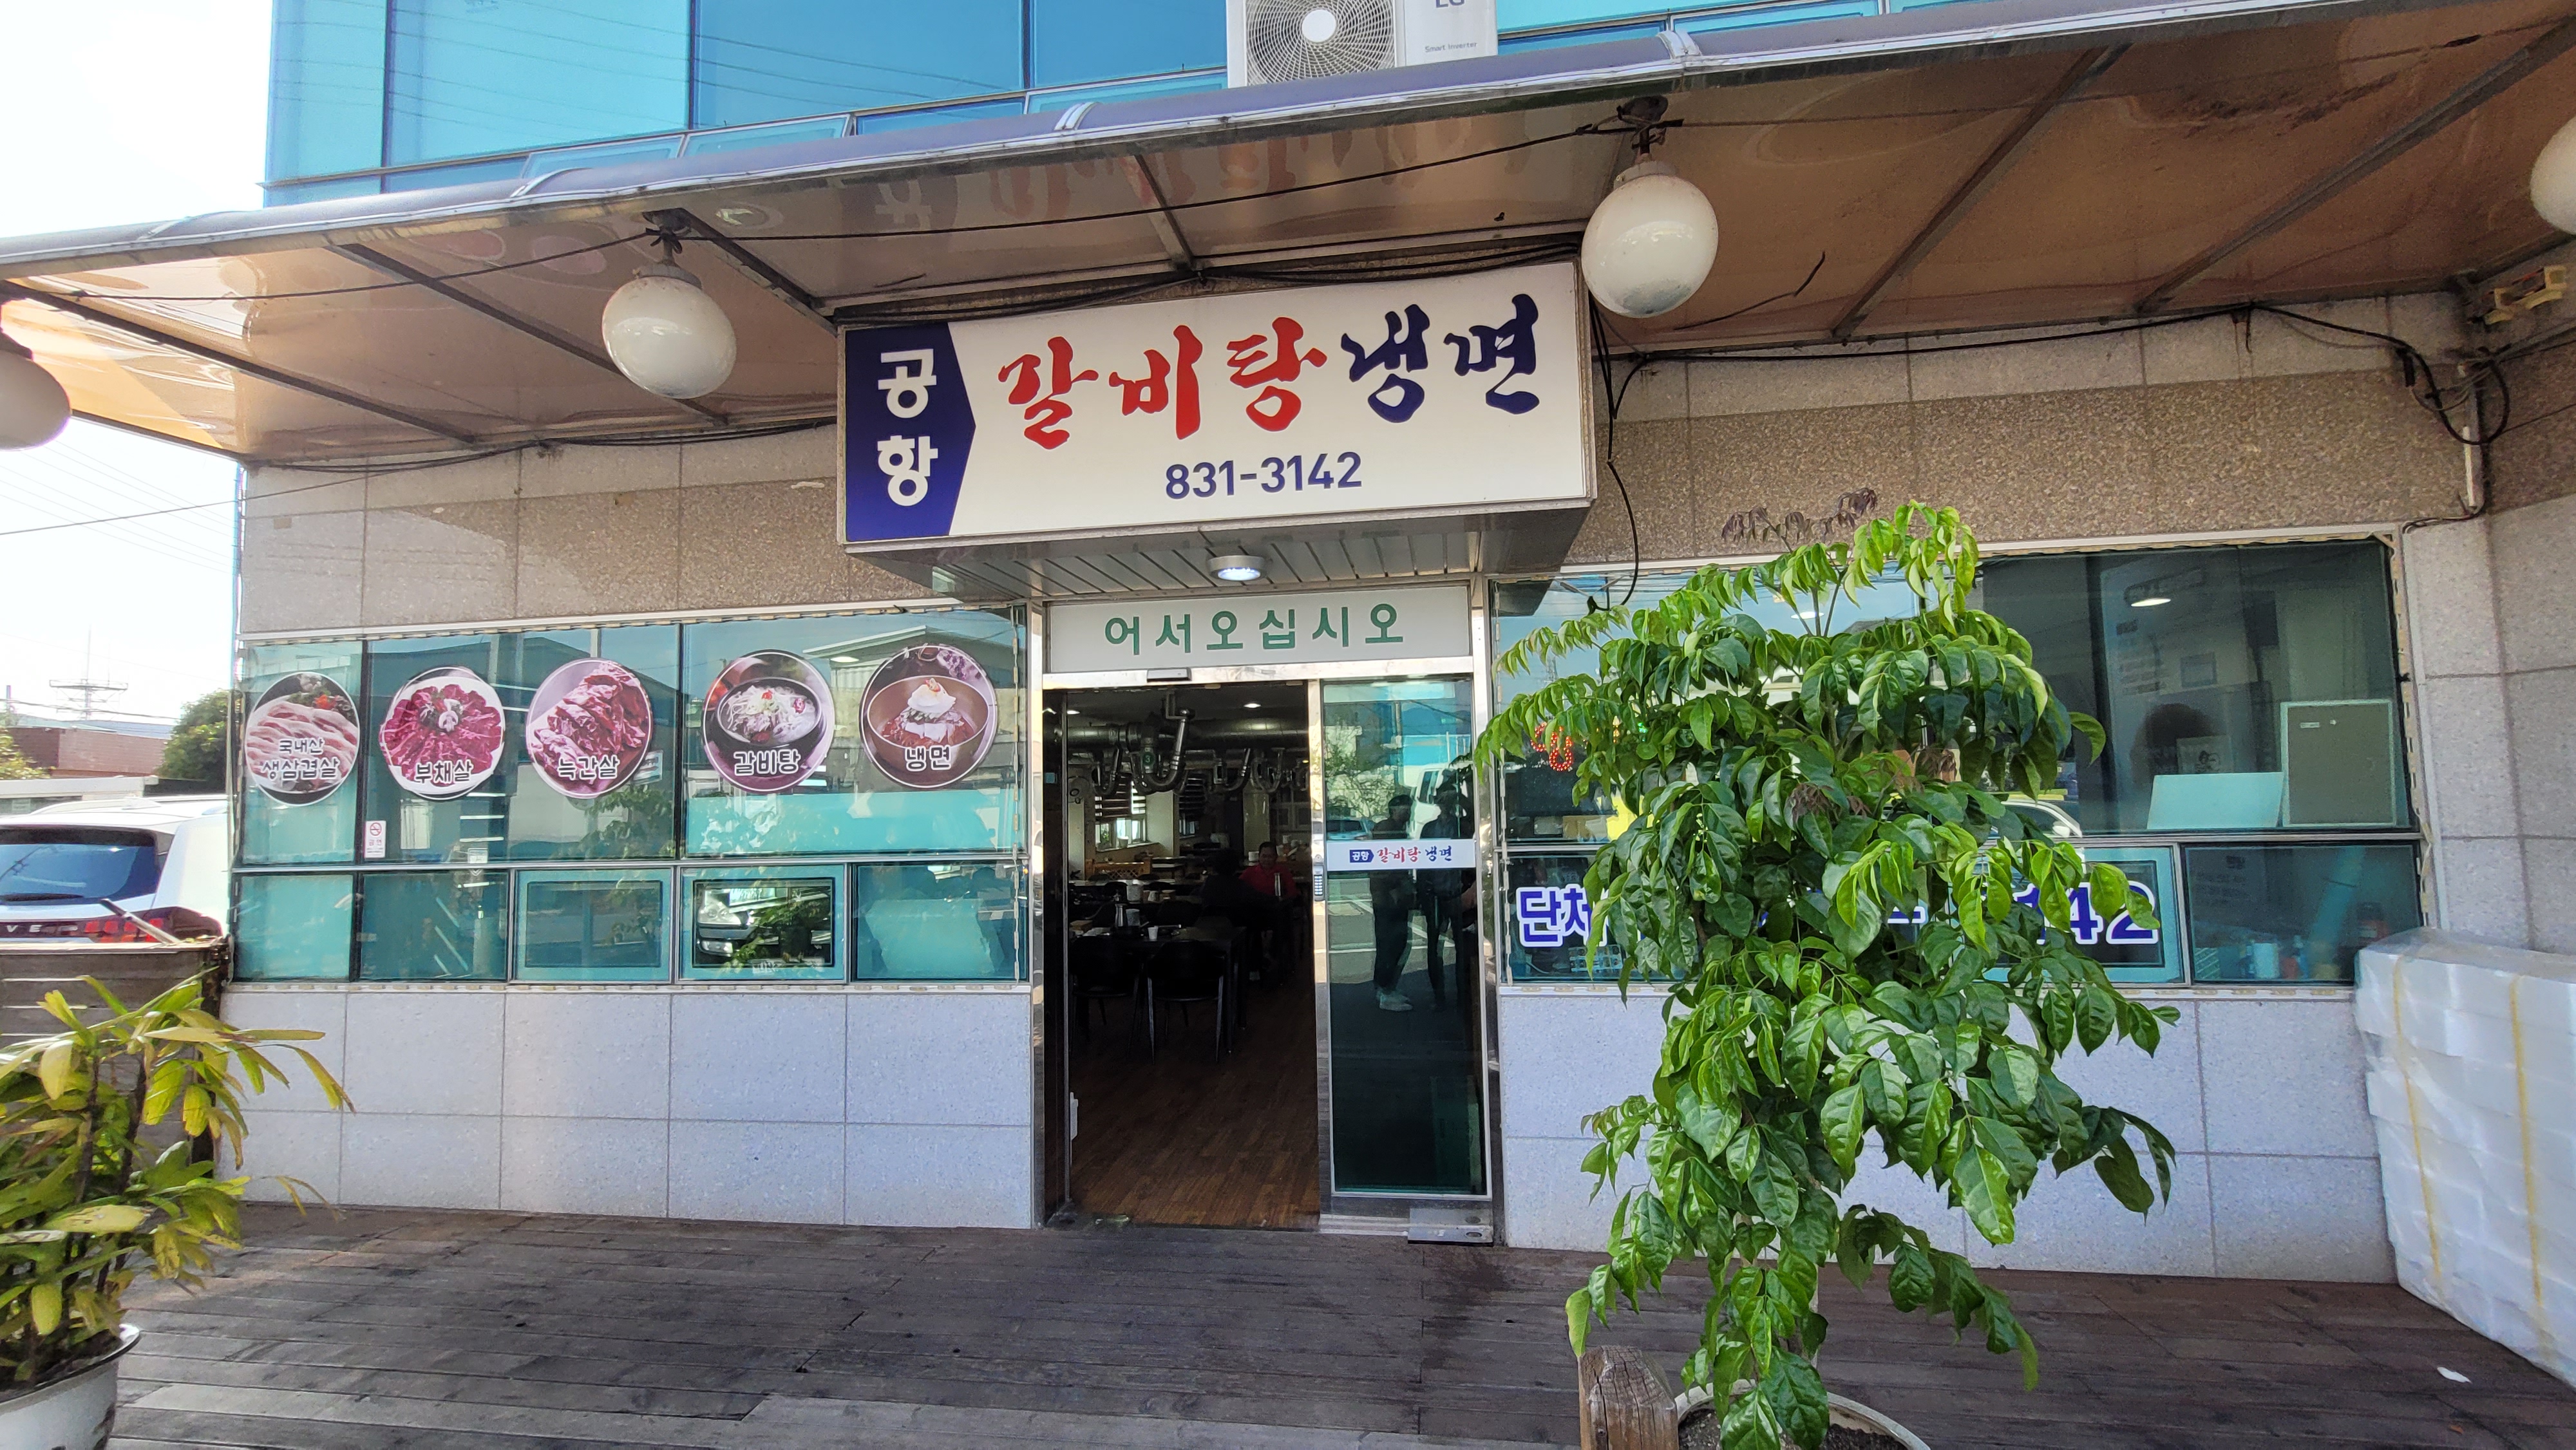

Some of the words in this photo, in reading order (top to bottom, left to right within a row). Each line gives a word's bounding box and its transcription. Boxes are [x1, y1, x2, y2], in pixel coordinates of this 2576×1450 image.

[998, 316, 1328, 449] 갈비탕
[1340, 293, 1540, 424] 냉면
[876, 348, 938, 507] 공항
[1164, 452, 1363, 500] 831-3142
[1104, 603, 1405, 655] 어서오십시오
[278, 738, 325, 755] 국내산
[904, 745, 952, 771] 냉면
[262, 757, 340, 780] 생삼겹살
[415, 759, 473, 784] 부채살
[557, 755, 621, 781] 늑간살
[733, 748, 801, 775] 갈비탕
[1352, 851, 1370, 862] 공항
[1376, 847, 1421, 863] 갈비탕
[1425, 845, 1452, 862] 냉면
